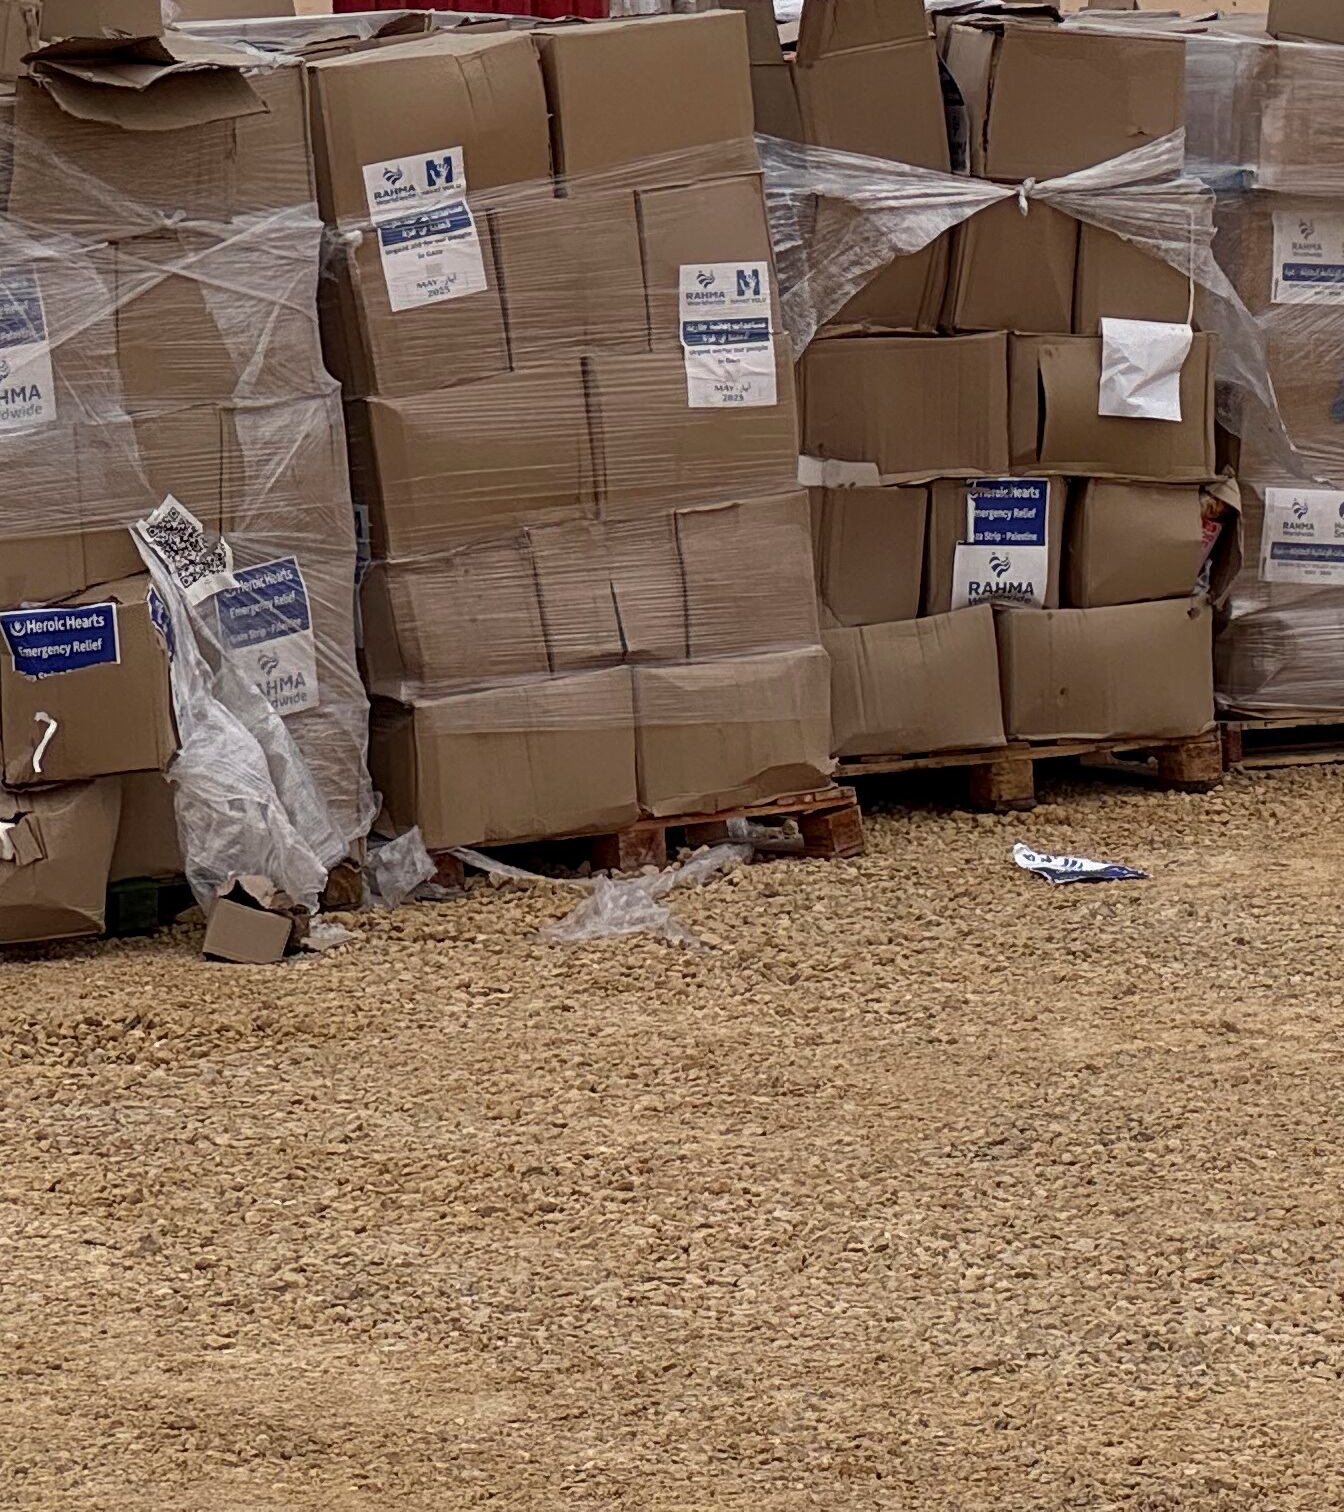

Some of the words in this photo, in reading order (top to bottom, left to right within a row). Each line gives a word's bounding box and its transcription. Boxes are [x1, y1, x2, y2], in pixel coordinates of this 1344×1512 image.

[374, 184, 416, 200] RAHMA
[686, 291, 726, 300] RAHMA
[1010, 486, 1040, 498] Hearts
[974, 508, 1012, 520] mergency
[1282, 522, 1314, 530] RAHMA
[968, 582, 1034, 596] RAHMA
[274, 590, 296, 608] Relief
[26, 616, 66, 634] Heroic
[66, 614, 105, 630] Hearts
[72, 638, 103, 654] Relief
